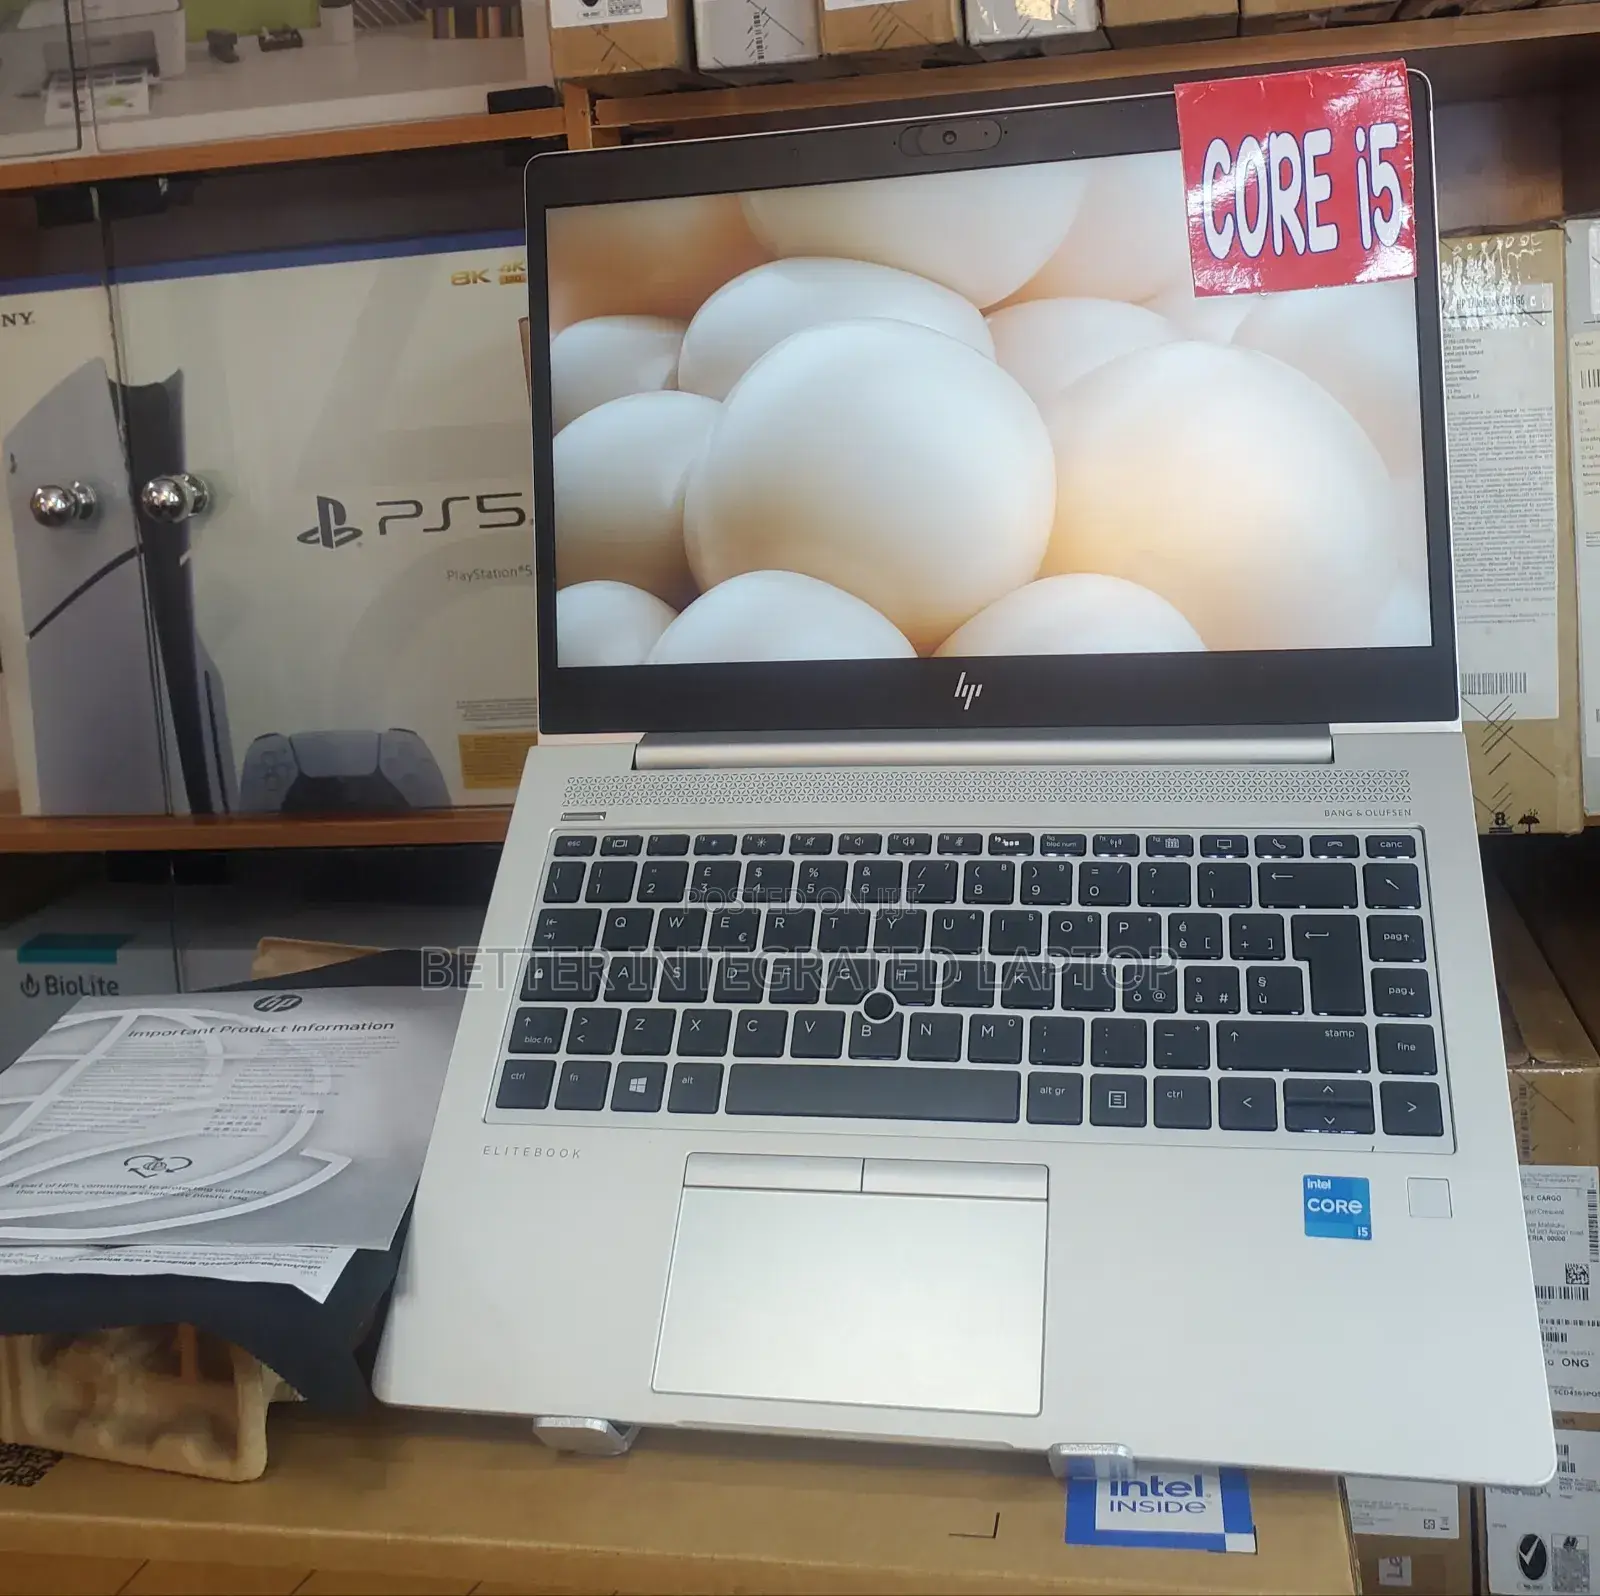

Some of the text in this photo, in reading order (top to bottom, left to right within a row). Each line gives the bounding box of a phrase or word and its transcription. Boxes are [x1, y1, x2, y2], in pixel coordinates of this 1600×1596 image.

[1202, 121, 1404, 260] CORE i5
[451, 269, 491, 286] 8K
[376, 492, 527, 536] PS5
[1324, 808, 1412, 817] BANG & OLUFSEN
[567, 839, 581, 848] esc
[703, 866, 712, 877] £
[755, 867, 763, 878] $
[808, 867, 819, 878] %
[862, 866, 871, 877] &
[917, 866, 927, 879] /
[1059, 864, 1065, 872] 9
[1150, 868, 1157, 879] ?
[595, 883, 601, 894] 1
[646, 883, 656, 894] 2
[700, 883, 708, 894] 3
[752, 883, 762, 894] 4
[806, 883, 815, 894] 5
[861, 883, 870, 894] 6
[917, 883, 926, 894] 7
[974, 884, 983, 895] 8
[1031, 885, 1041, 896] 9
[615, 916, 626, 928] Q
[669, 916, 684, 928] W
[720, 916, 730, 928] E
[774, 917, 785, 929] R
[829, 917, 839, 929] T
[969, 913, 976, 921] 4
[1028, 913, 1034, 922] 5
[1087, 915, 1094, 923] 6
[886, 918, 897, 929] Y
[943, 918, 954, 930] U
[1060, 920, 1073, 932] O
[1119, 921, 1129, 933] P
[738, 931, 747, 943] €
[1241, 940, 1249, 949] +
[618, 966, 629, 978] A
[672, 967, 682, 979] S
[726, 967, 738, 979] D
[782, 967, 792, 979] F
[839, 968, 850, 980] G
[896, 969, 906, 981] H
[954, 970, 962, 983] J
[1101, 967, 1107, 976] 3
[1014, 972, 1024, 984] K
[1073, 973, 1083, 986] L
[1258, 976, 1267, 988] §
[45, 973, 120, 996] BioLite
[1152, 989, 1166, 1003] @
[1219, 992, 1229, 1003] #
[128, 1020, 395, 1038] Important Product Information
[634, 1018, 646, 1031] Z
[690, 1019, 702, 1032] X
[746, 1020, 758, 1032] C
[804, 1021, 816, 1033] V
[861, 1024, 872, 1037] B
[920, 1023, 932, 1036] N
[981, 1025, 995, 1038] M
[1324, 1028, 1355, 1039] stamp
[524, 1034, 553, 1044] bloc fn
[1397, 1041, 1416, 1052] fine
[510, 1071, 526, 1080] ctrl
[569, 1072, 579, 1083] fn
[681, 1075, 694, 1085] alt
[1040, 1086, 1066, 1096] alt gr
[1166, 1089, 1183, 1099] ctrl
[482, 1145, 582, 1160] ELITEBOOK
[1307, 1178, 1332, 1190] intel
[1536, 1194, 1562, 1202] CARGO
[1357, 1226, 1369, 1238] i5
[1561, 1357, 1590, 1368] ONG
